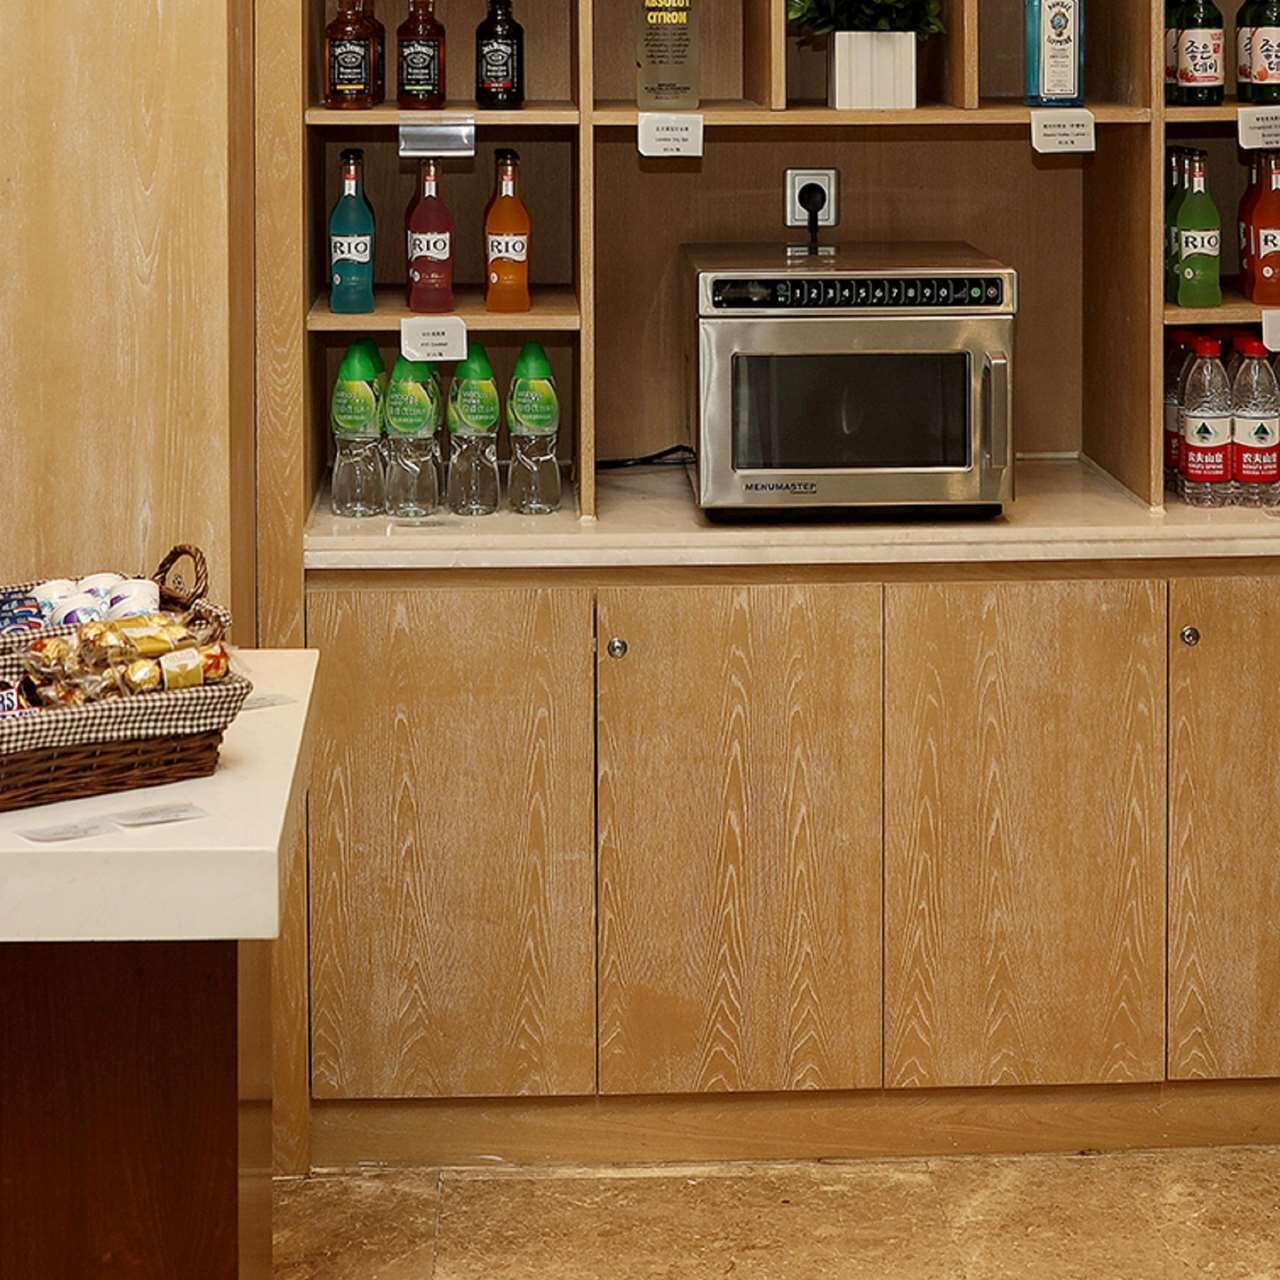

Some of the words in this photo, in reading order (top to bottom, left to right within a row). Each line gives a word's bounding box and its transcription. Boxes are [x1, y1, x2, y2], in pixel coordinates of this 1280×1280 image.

[647, 11, 688, 24] CITRON
[1185, 40, 1213, 61] 좋은
[1192, 60, 1218, 74] 데이
[333, 242, 369, 255] RIO
[413, 237, 447, 252] RIO
[490, 239, 525, 254] RIO
[1184, 235, 1218, 249] RIO
[795, 288, 801, 298] 1
[810, 288, 818, 298] 2
[826, 288, 834, 298] 3
[842, 288, 849, 298] 4
[859, 288, 866, 298] 5
[874, 288, 882, 298] 6
[891, 288, 898, 298] 7
[907, 288, 915, 298] 8
[923, 288, 931, 298] 9
[939, 288, 947, 298] 0
